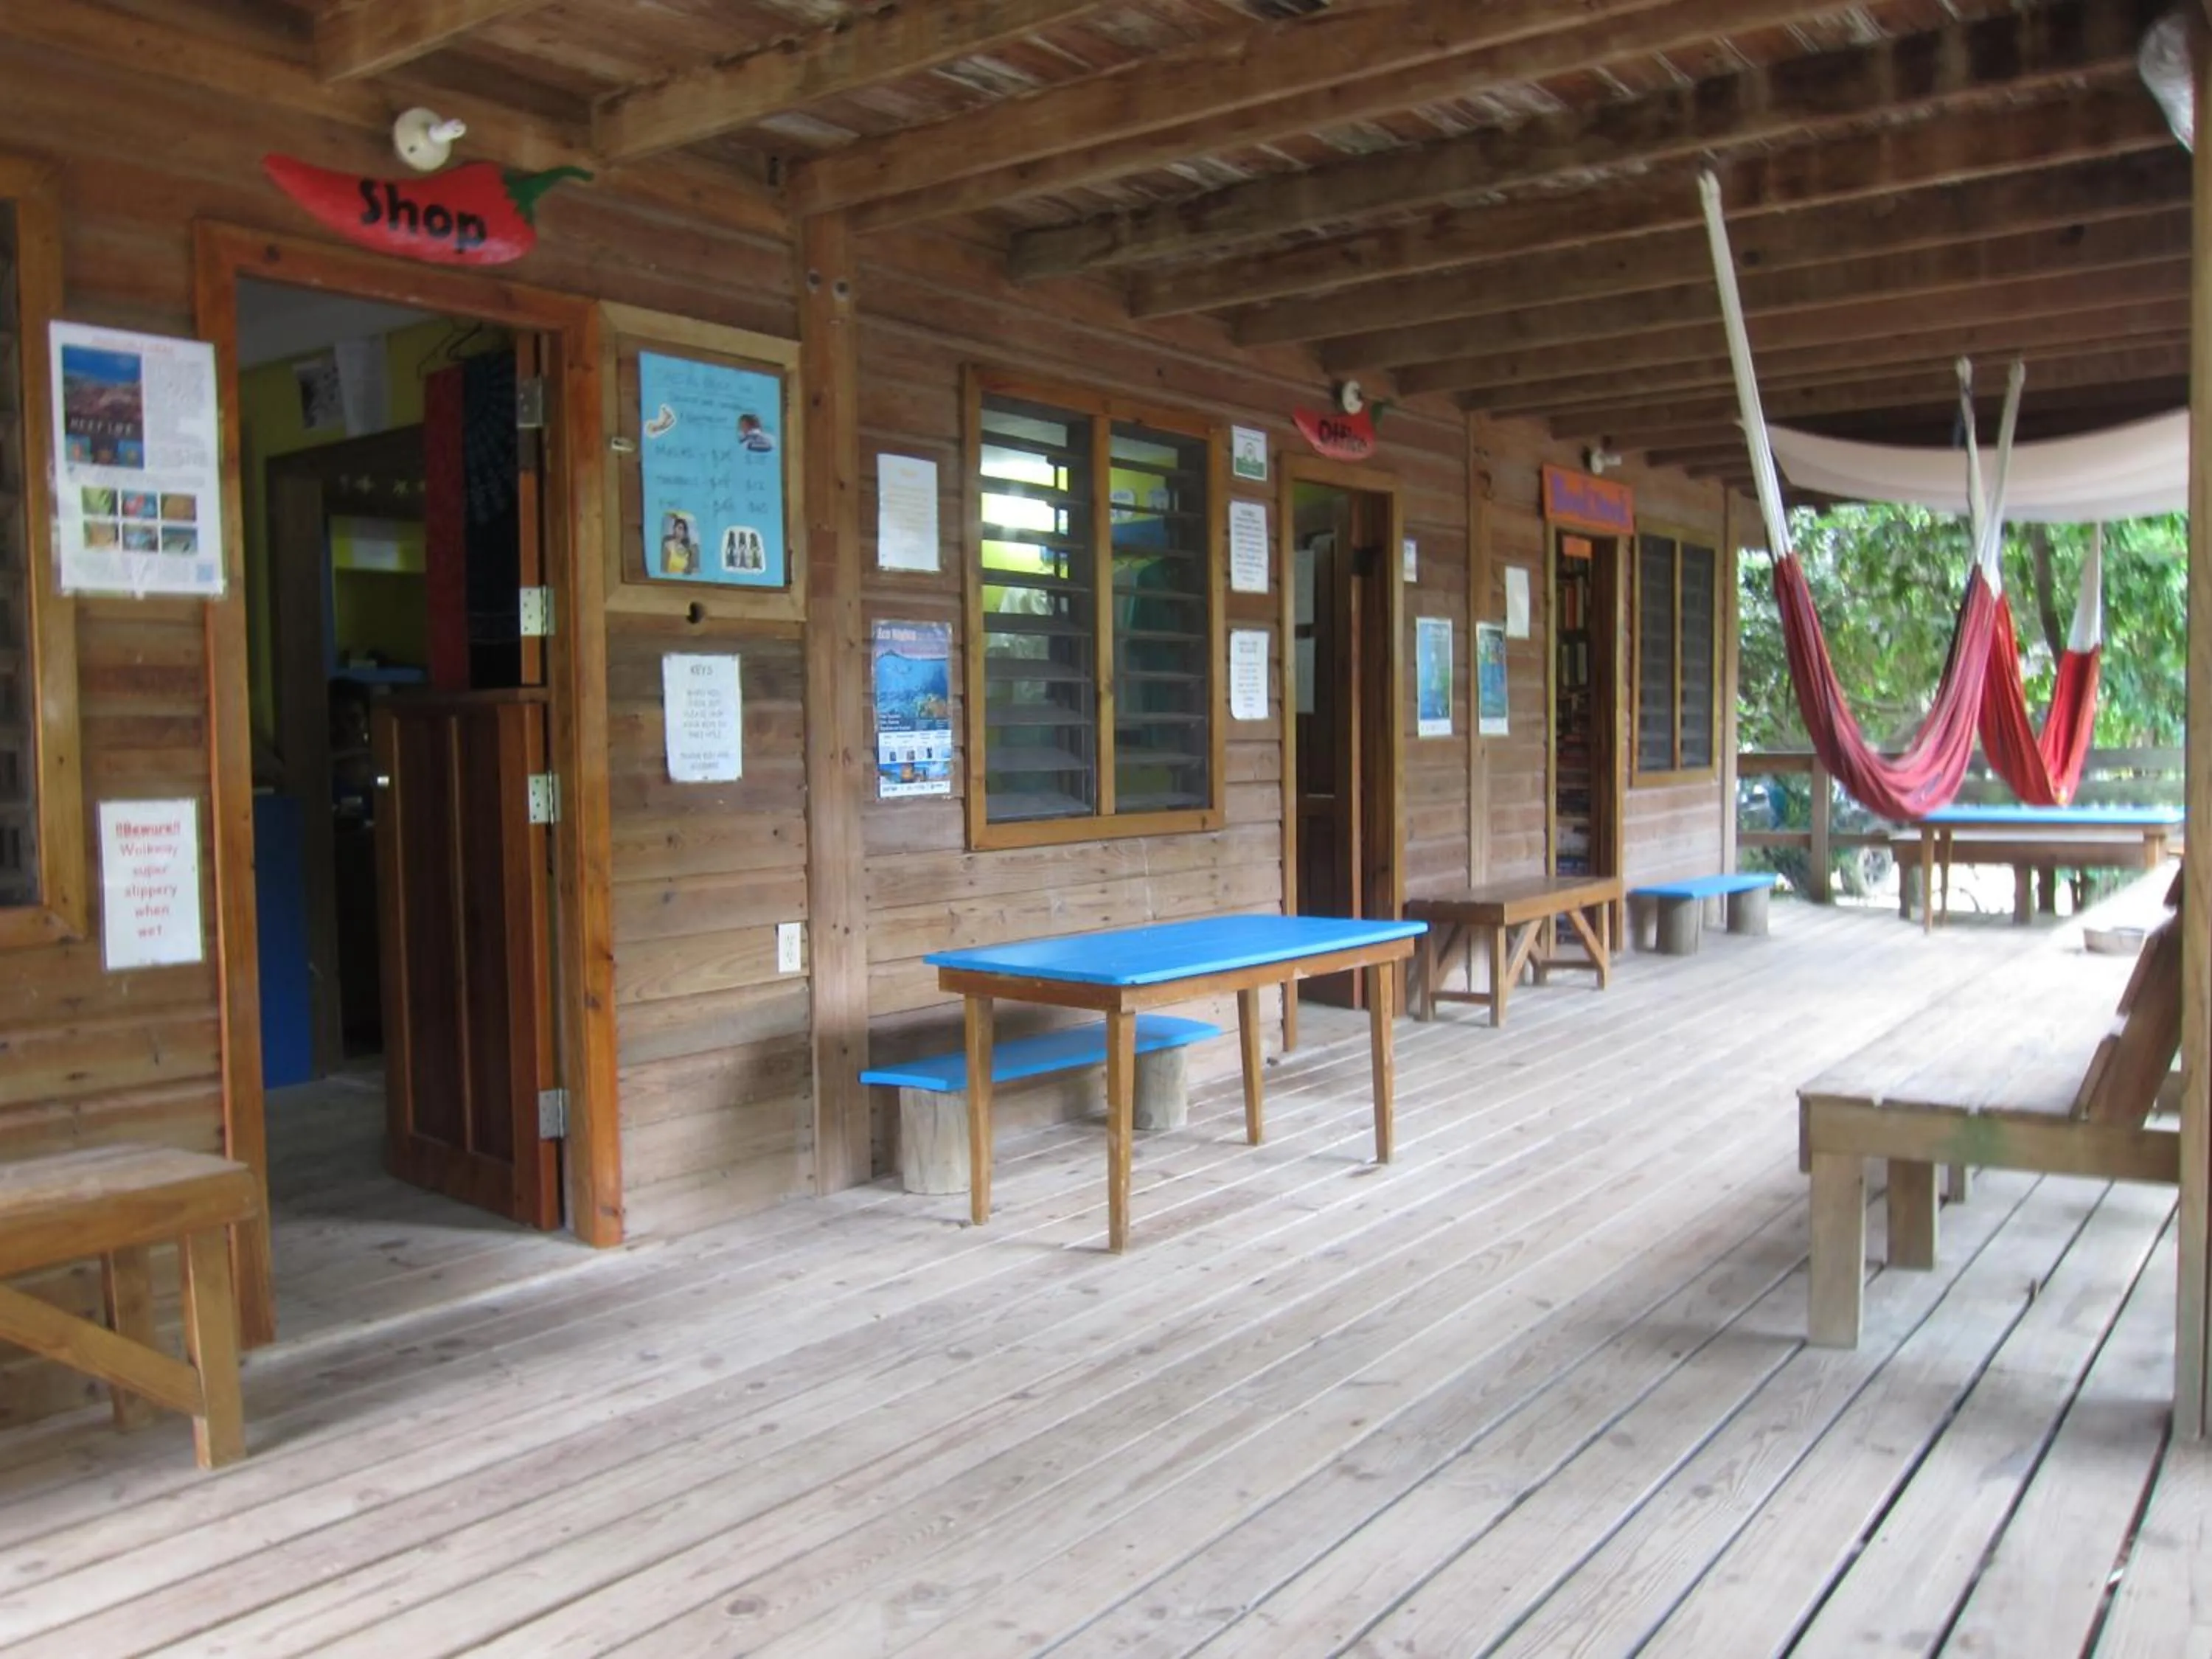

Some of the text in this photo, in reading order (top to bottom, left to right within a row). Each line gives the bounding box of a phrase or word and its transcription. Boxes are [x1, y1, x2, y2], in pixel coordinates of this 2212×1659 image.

[360, 179, 487, 253] Shop
[690, 664, 714, 676] KEYS
[133, 866, 168, 878] super
[125, 883, 178, 901] slippery
[136, 905, 170, 917] when
[138, 924, 161, 938] wet
